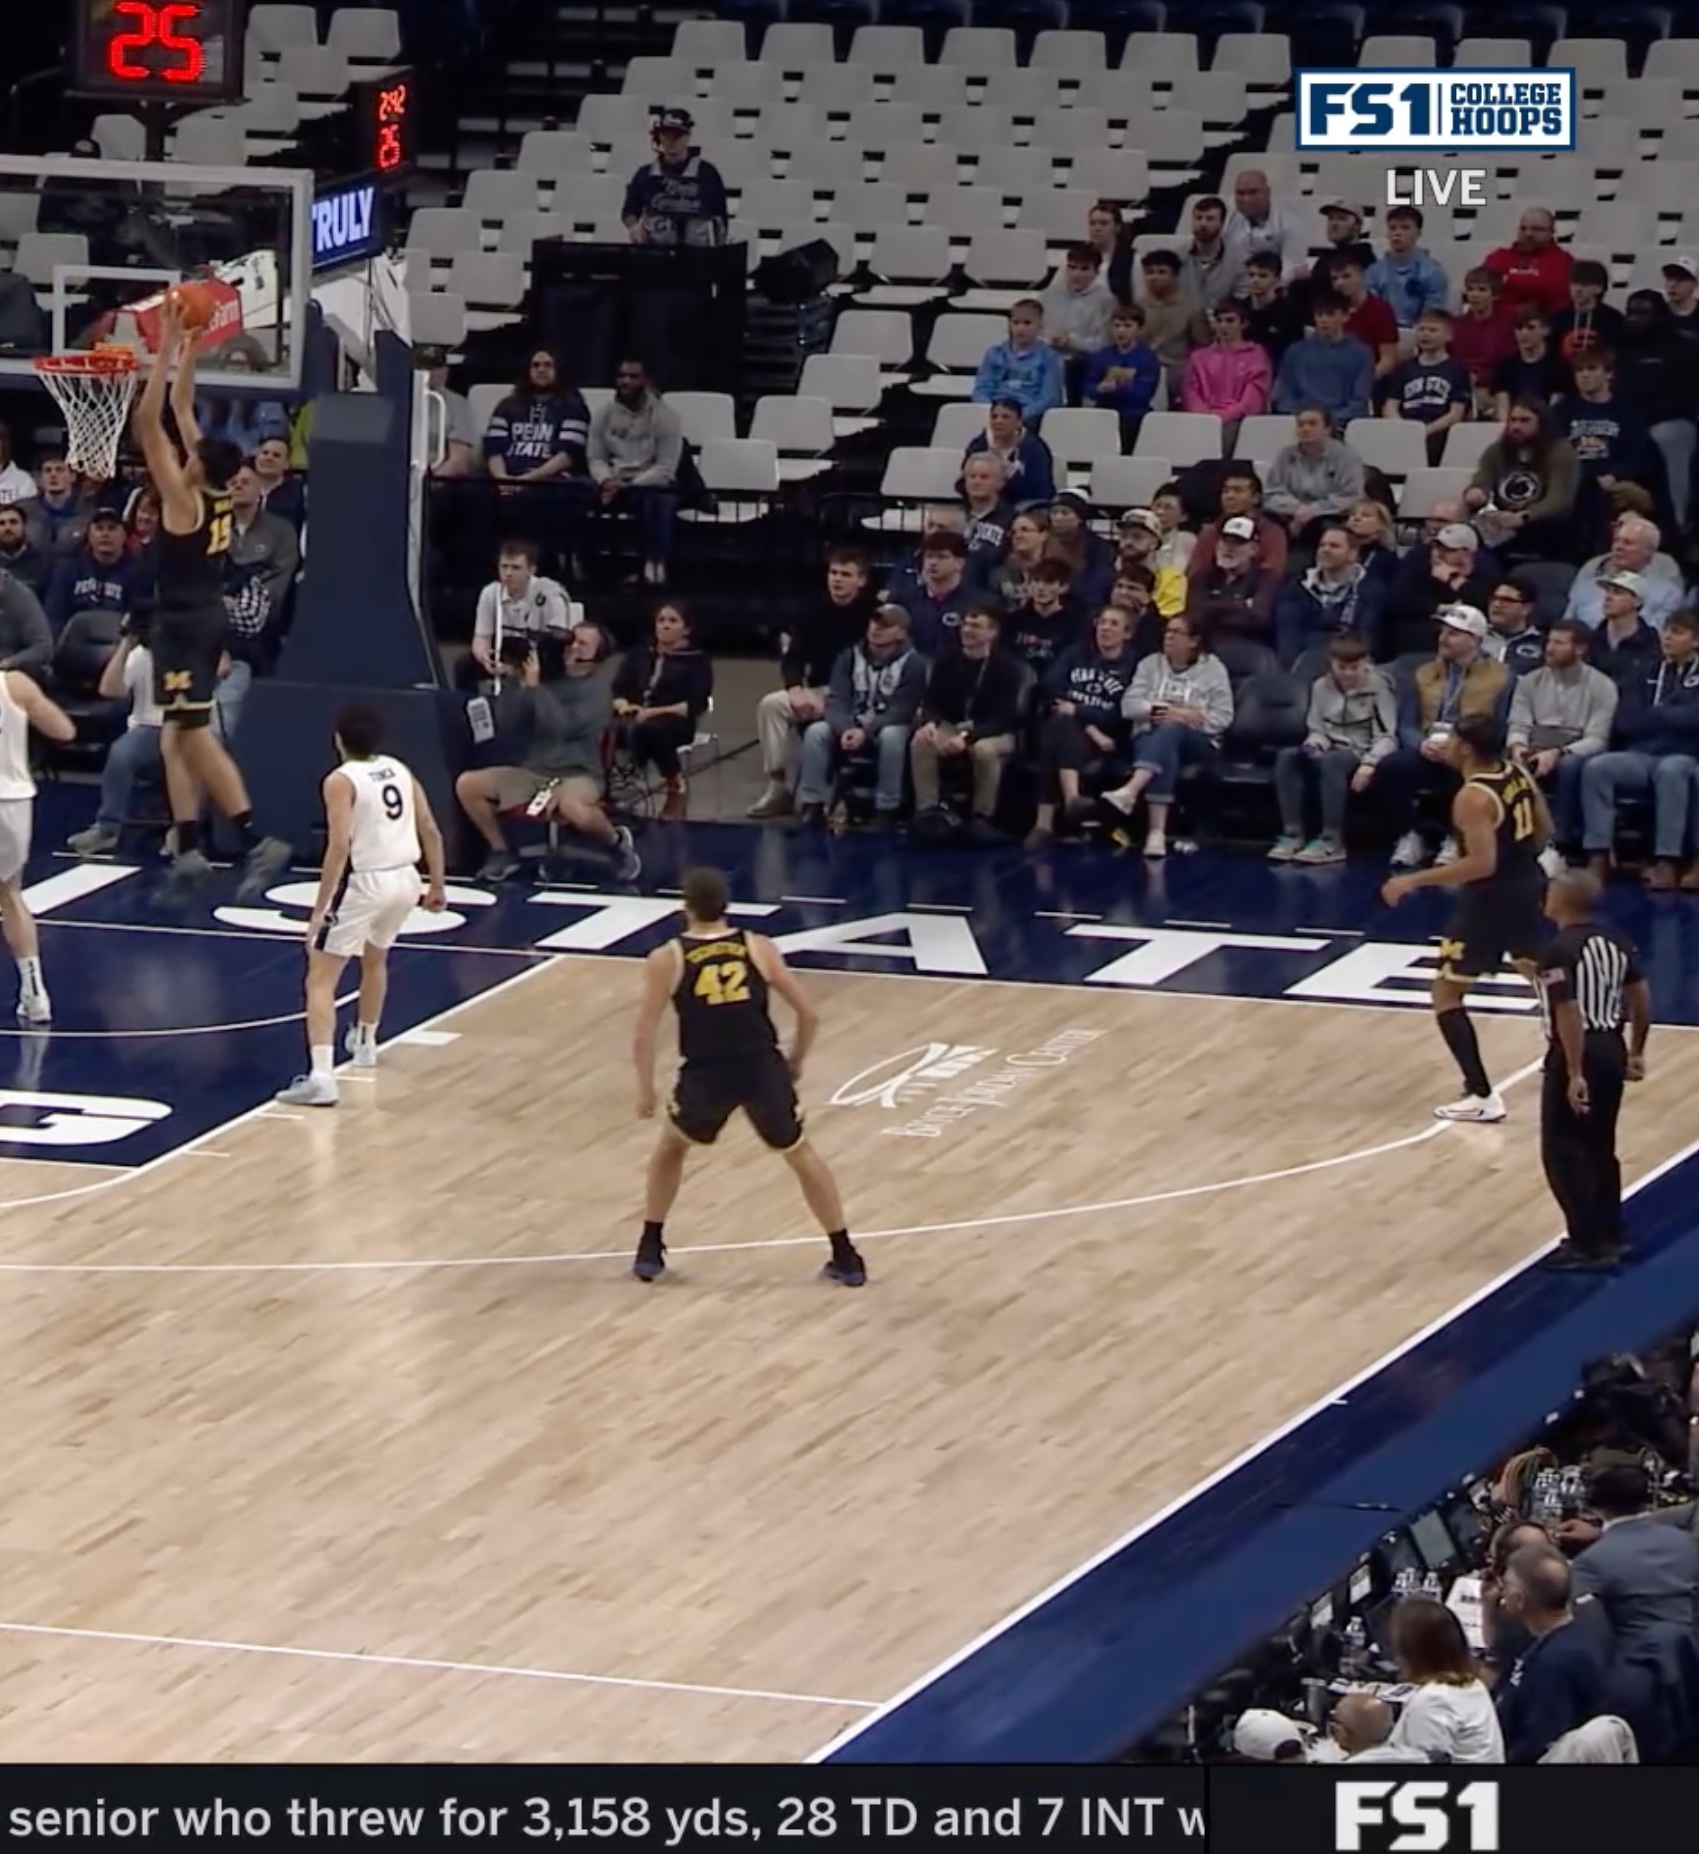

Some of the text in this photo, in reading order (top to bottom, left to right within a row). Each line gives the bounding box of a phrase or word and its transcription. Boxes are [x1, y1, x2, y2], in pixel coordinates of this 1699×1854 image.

[110, 2, 203, 82] 25
[379, 123, 401, 169] 25
[510, 421, 554, 441] PENN
[382, 784, 404, 821] 9
[1512, 797, 1534, 841] 11
[212, 880, 1541, 1012] STATE
[693, 960, 751, 1006] 42
